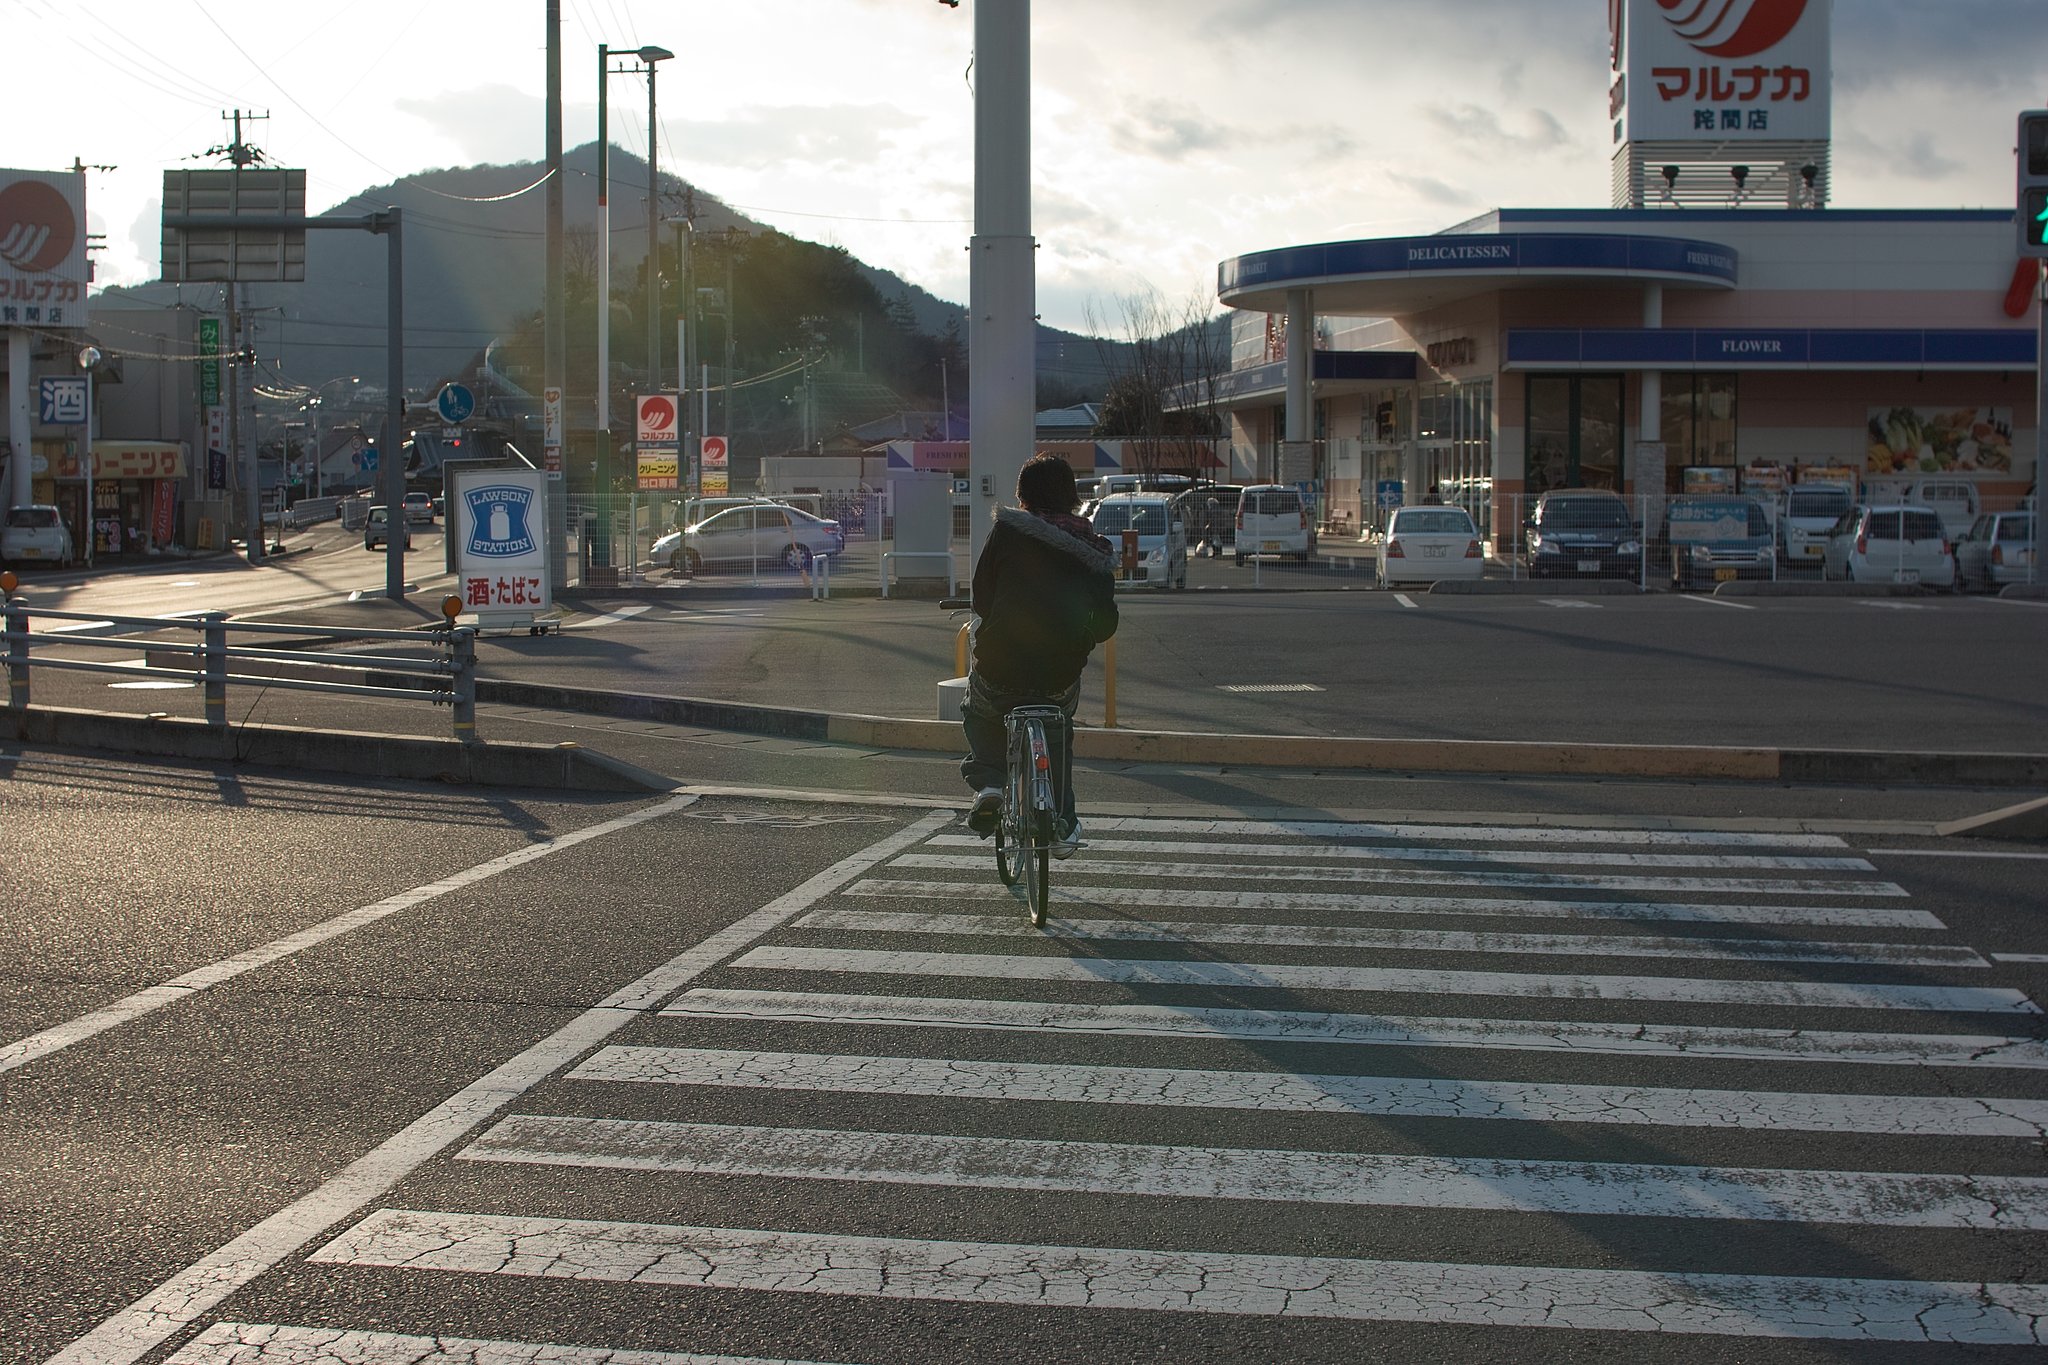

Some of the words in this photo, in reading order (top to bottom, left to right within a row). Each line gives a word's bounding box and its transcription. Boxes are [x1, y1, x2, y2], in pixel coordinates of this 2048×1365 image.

[1651, 65, 1810, 102] マルナカ
[1693, 108, 1769, 131] 詫間店
[1408, 244, 1511, 261] DELICATESSEN
[1687, 251, 1710, 266] FRESH
[1721, 339, 1782, 354] FLOWER
[42, 380, 86, 422] 酒
[640, 432, 675, 440] マルナカ
[925, 451, 951, 460] FRESH
[639, 464, 677, 474] クリーニング
[639, 477, 678, 489] 出口専用
[471, 490, 528, 506] LAWSON
[1671, 506, 1715, 521] お静かに
[472, 537, 530, 553] STATION
[466, 575, 542, 606] 酒・たばこ
